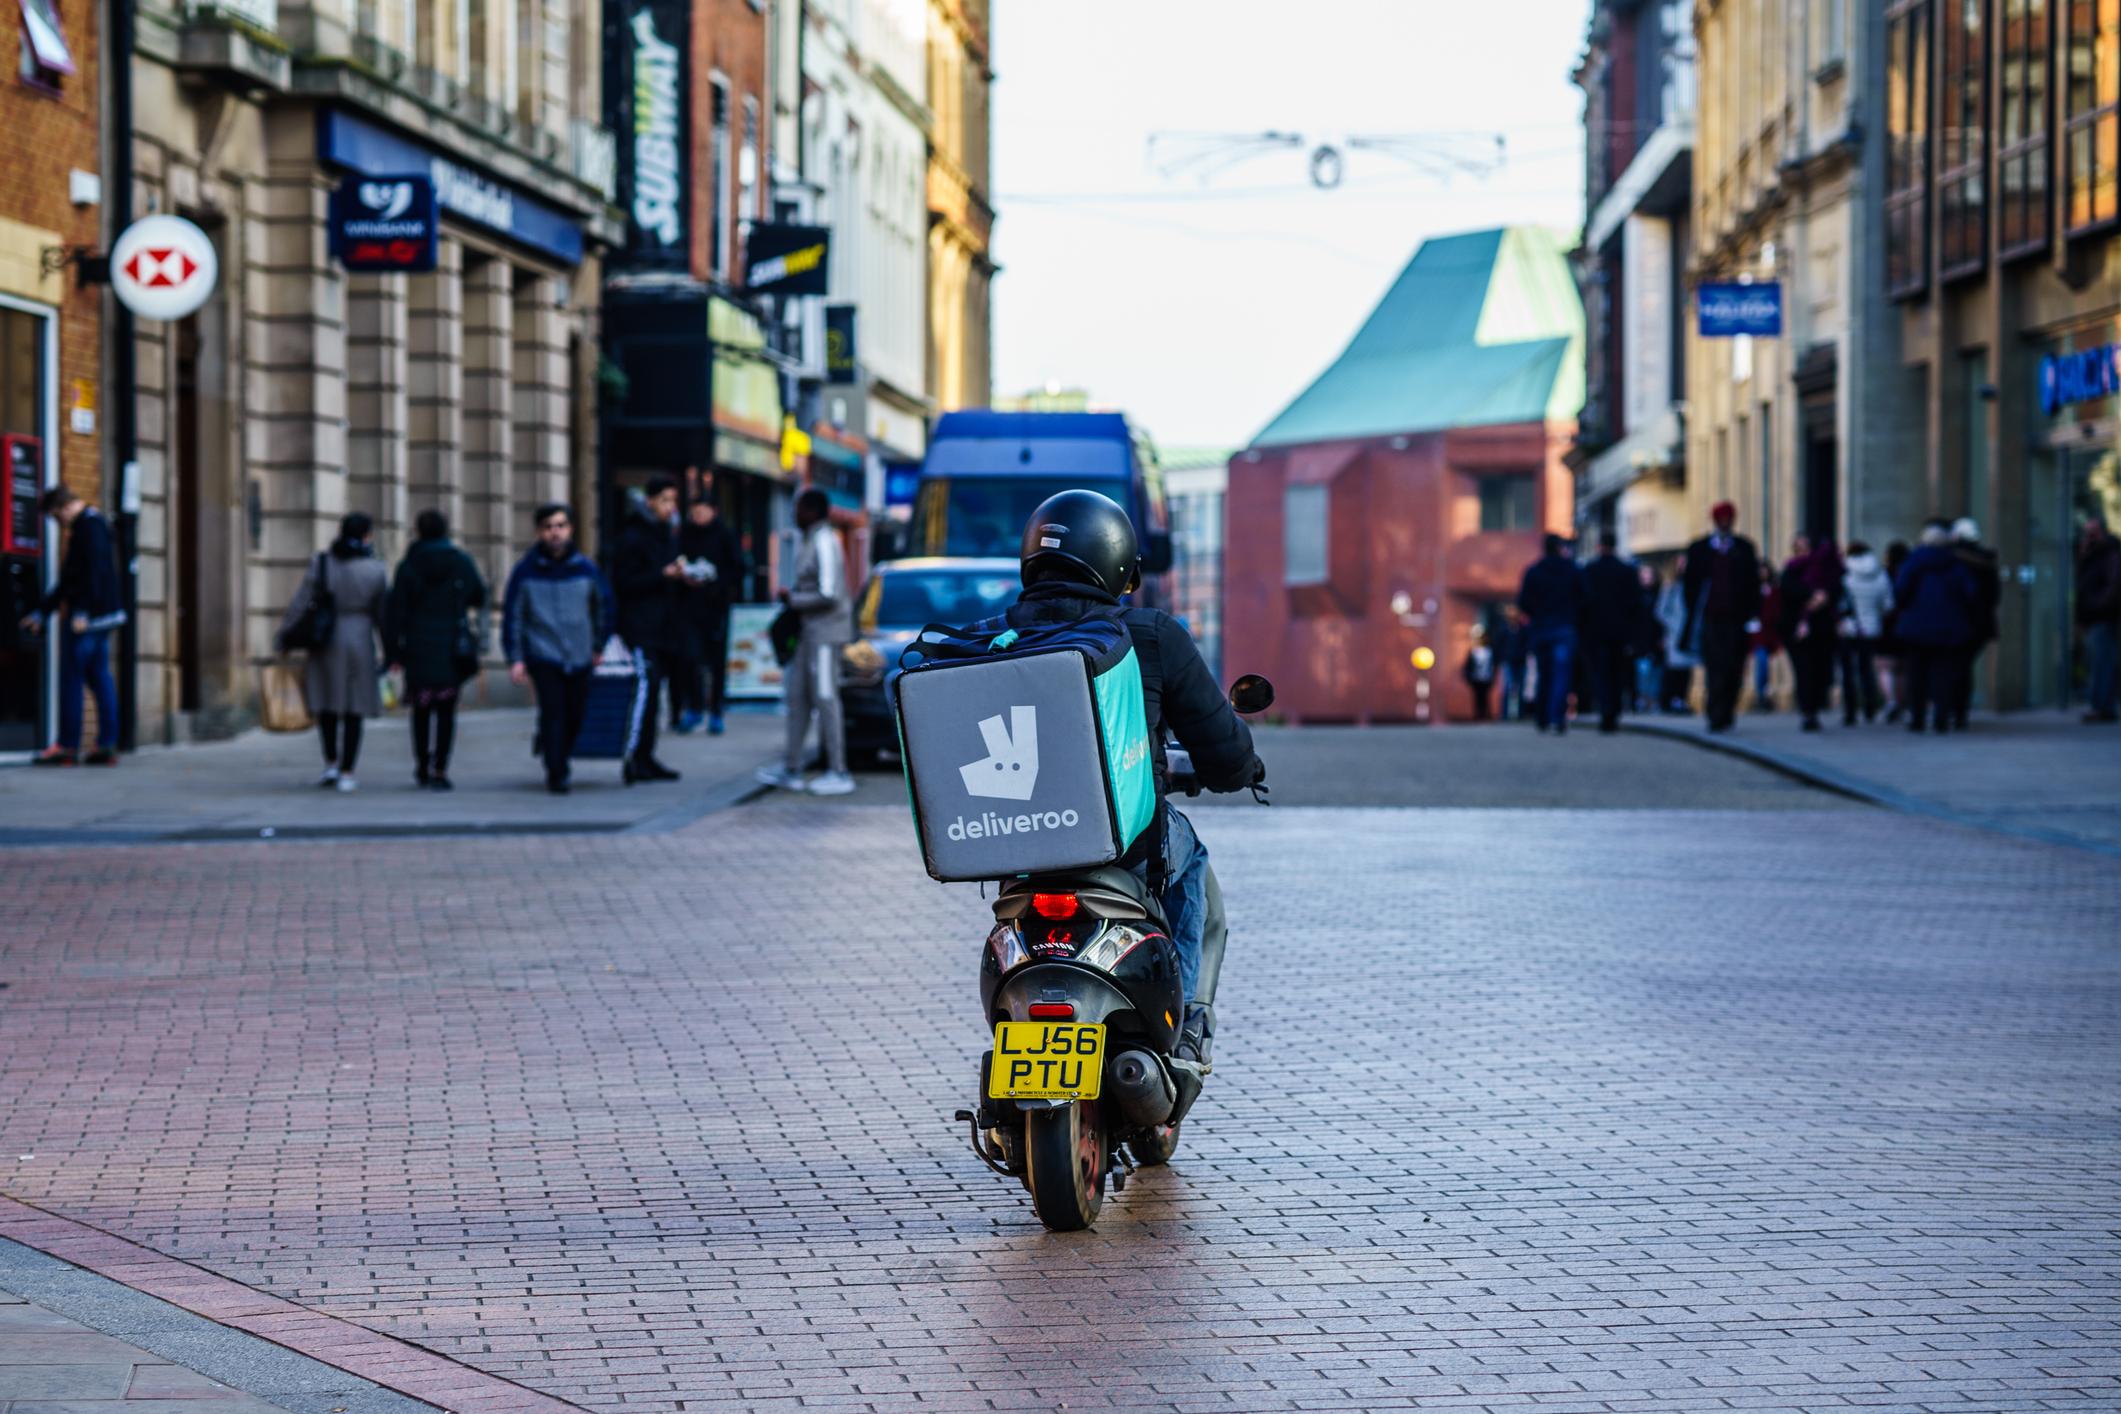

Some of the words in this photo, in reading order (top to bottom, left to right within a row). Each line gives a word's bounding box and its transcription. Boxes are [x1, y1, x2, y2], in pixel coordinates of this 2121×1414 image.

[632, 8, 679, 243] SUBWAY
[947, 809, 1079, 841] deliveroo
[1032, 942, 1075, 951] CANYON
[1001, 1026, 1098, 1055] LJ56
[1009, 1059, 1083, 1088] PTU
